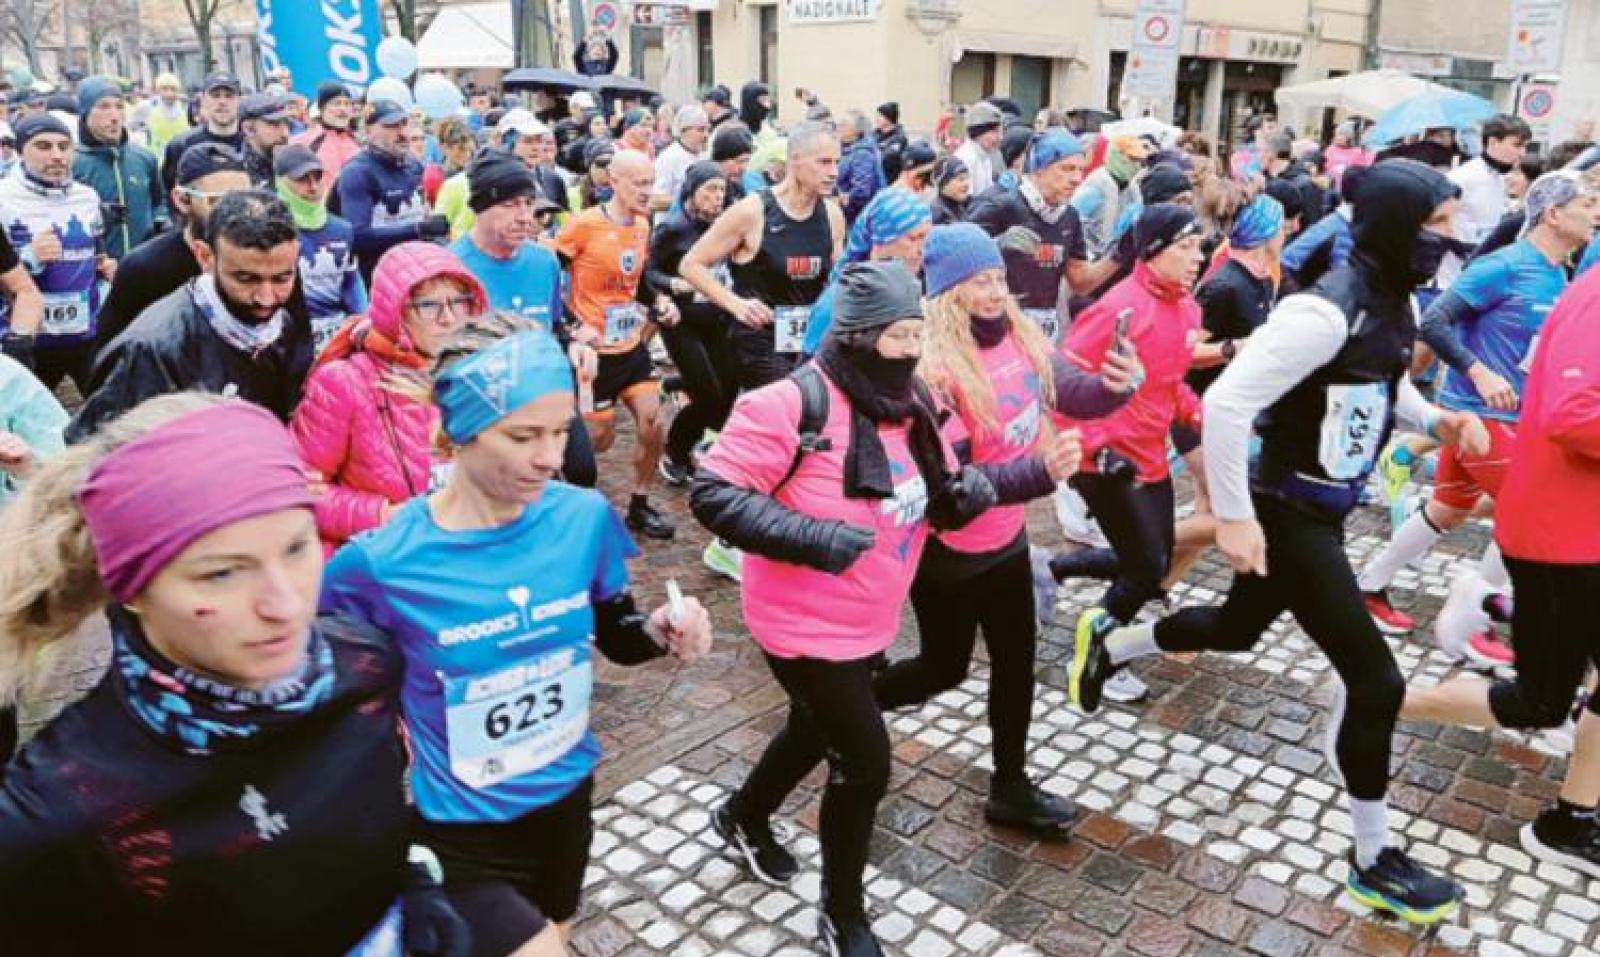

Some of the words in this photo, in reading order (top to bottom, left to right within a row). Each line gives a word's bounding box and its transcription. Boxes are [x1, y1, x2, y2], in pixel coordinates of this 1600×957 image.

[1345, 405, 1373, 457] 294
[438, 612, 518, 646] BROOKS
[484, 682, 564, 739] 623
